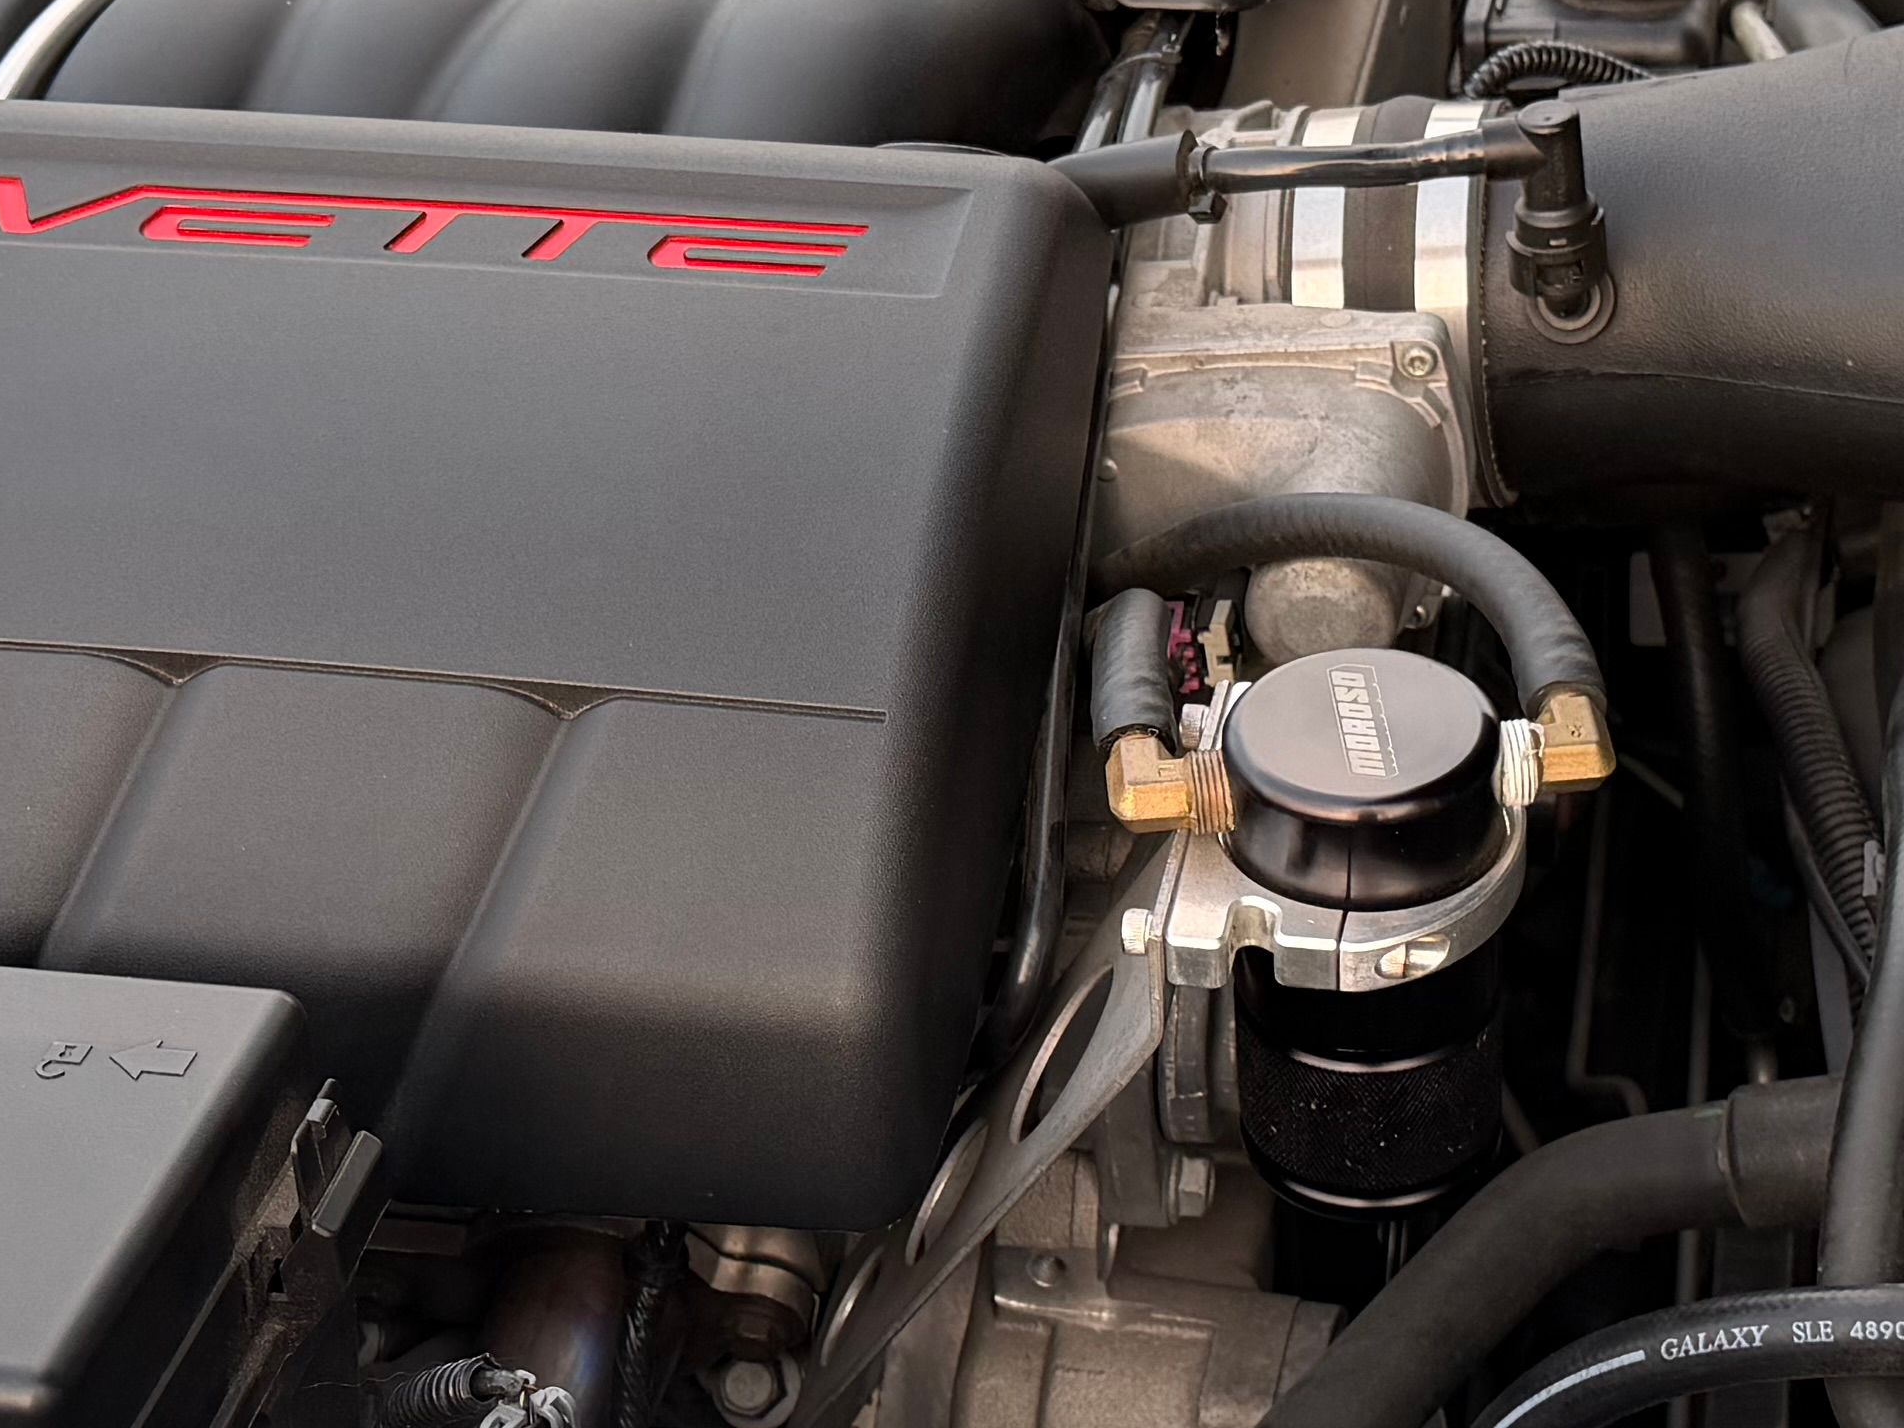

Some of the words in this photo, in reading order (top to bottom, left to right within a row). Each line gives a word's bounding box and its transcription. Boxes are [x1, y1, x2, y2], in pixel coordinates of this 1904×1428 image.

[1330, 670, 1387, 777] MOROSO
[1660, 1324, 1769, 1360] GALAXY
[1792, 1320, 1834, 1343] SLE
